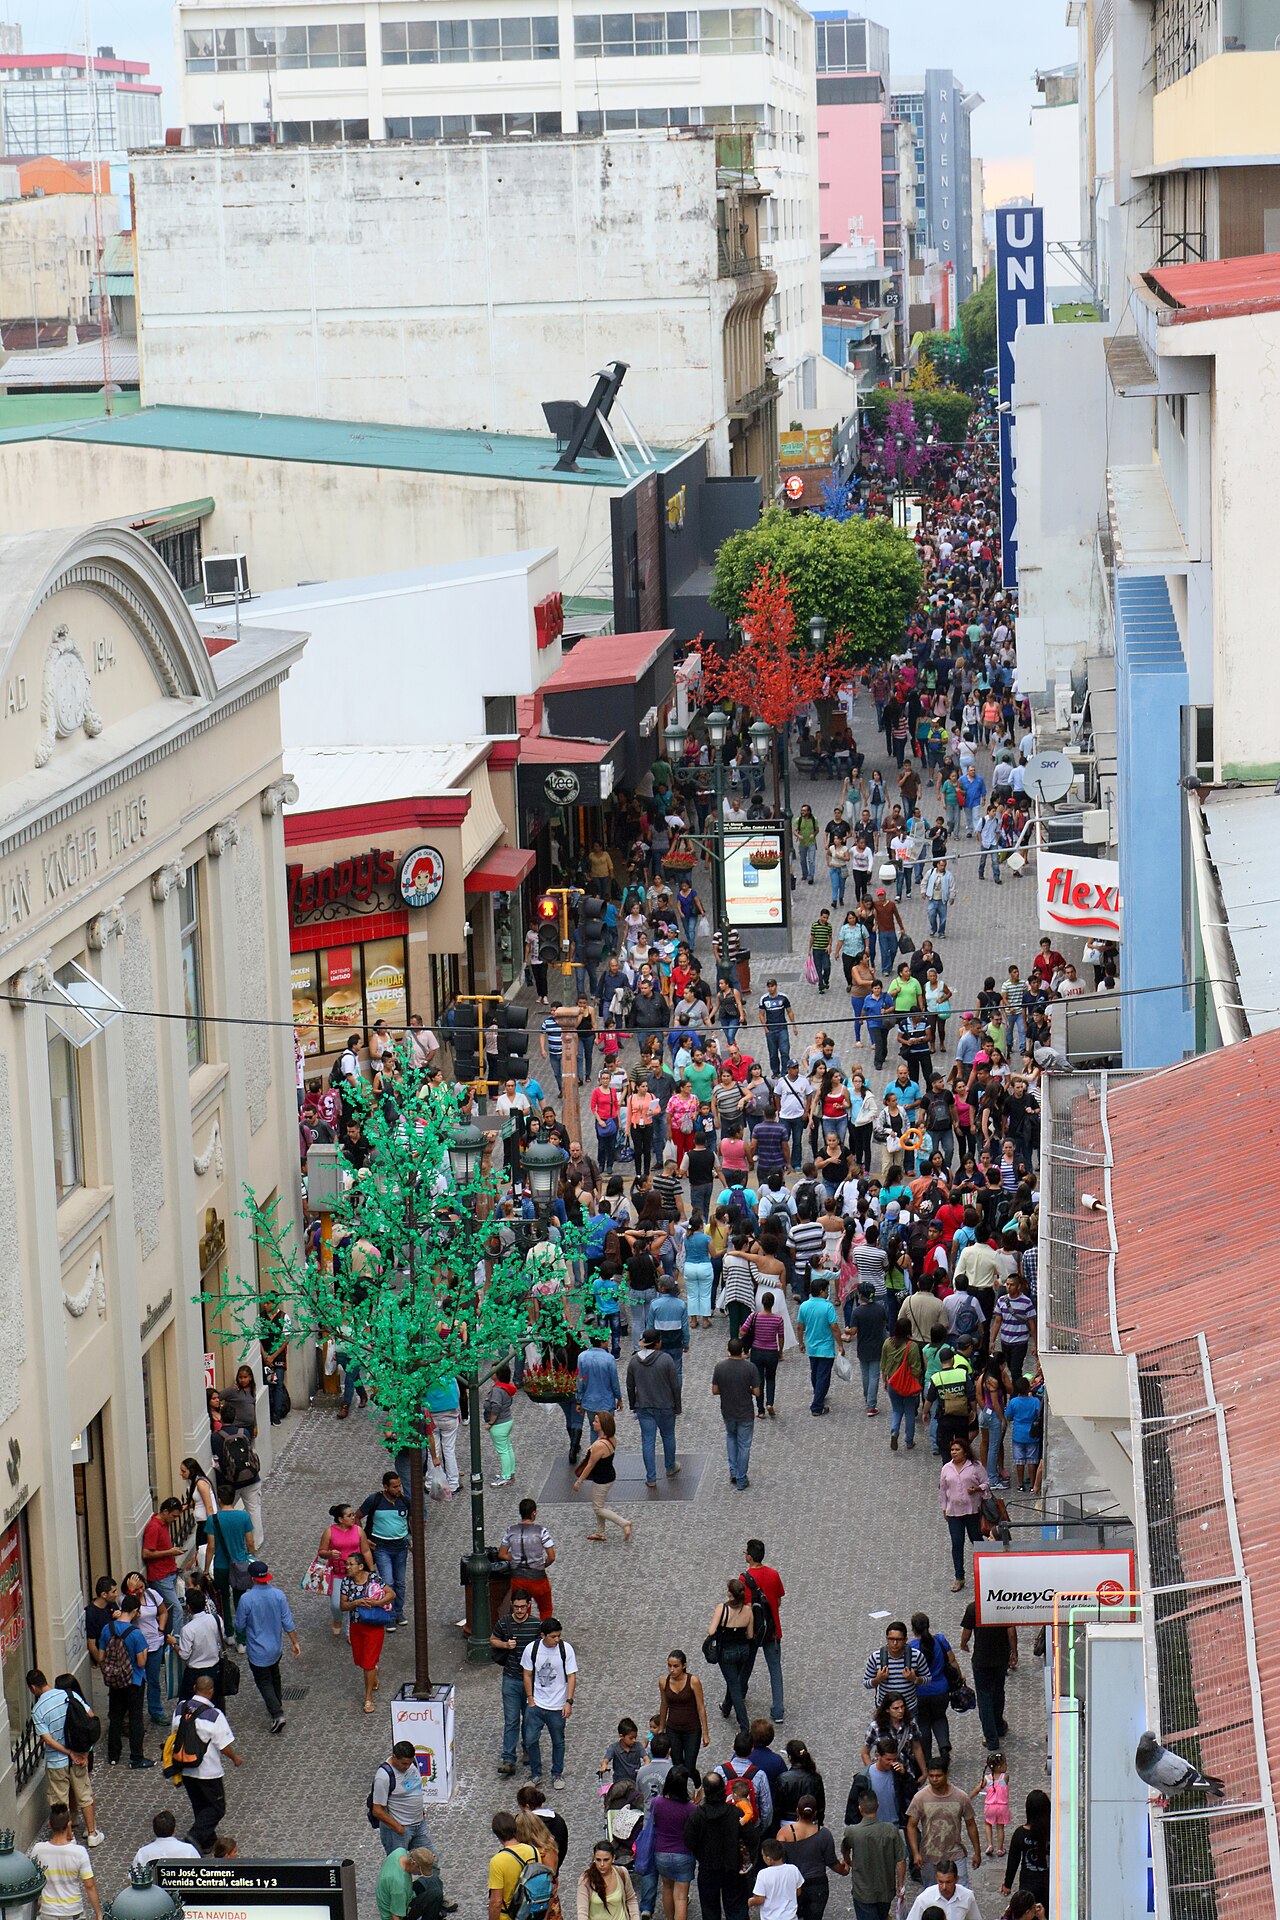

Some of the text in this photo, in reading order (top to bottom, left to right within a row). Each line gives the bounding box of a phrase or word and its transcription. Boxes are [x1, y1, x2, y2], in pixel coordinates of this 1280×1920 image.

[939, 89, 951, 252] RAVENTOS
[886, 294, 899, 304] P3
[1040, 760, 1060, 769] SKY
[549, 776, 574, 790] Lee
[403, 855, 417, 876] QUALITY
[330, 973, 351, 982] LIMITADO
[366, 974, 404, 988] CHEDDAR
[366, 988, 404, 1004] LOVERS
[986, 1588, 1088, 1605] MoneyGam
[409, 1709, 434, 1722] cnfl
[160, 1868, 235, 1879] San José, Carmen:
[161, 1878, 278, 1889] Avenida Central, calles 1 y 3
[205, 1911, 248, 1920] NAVIDAD
